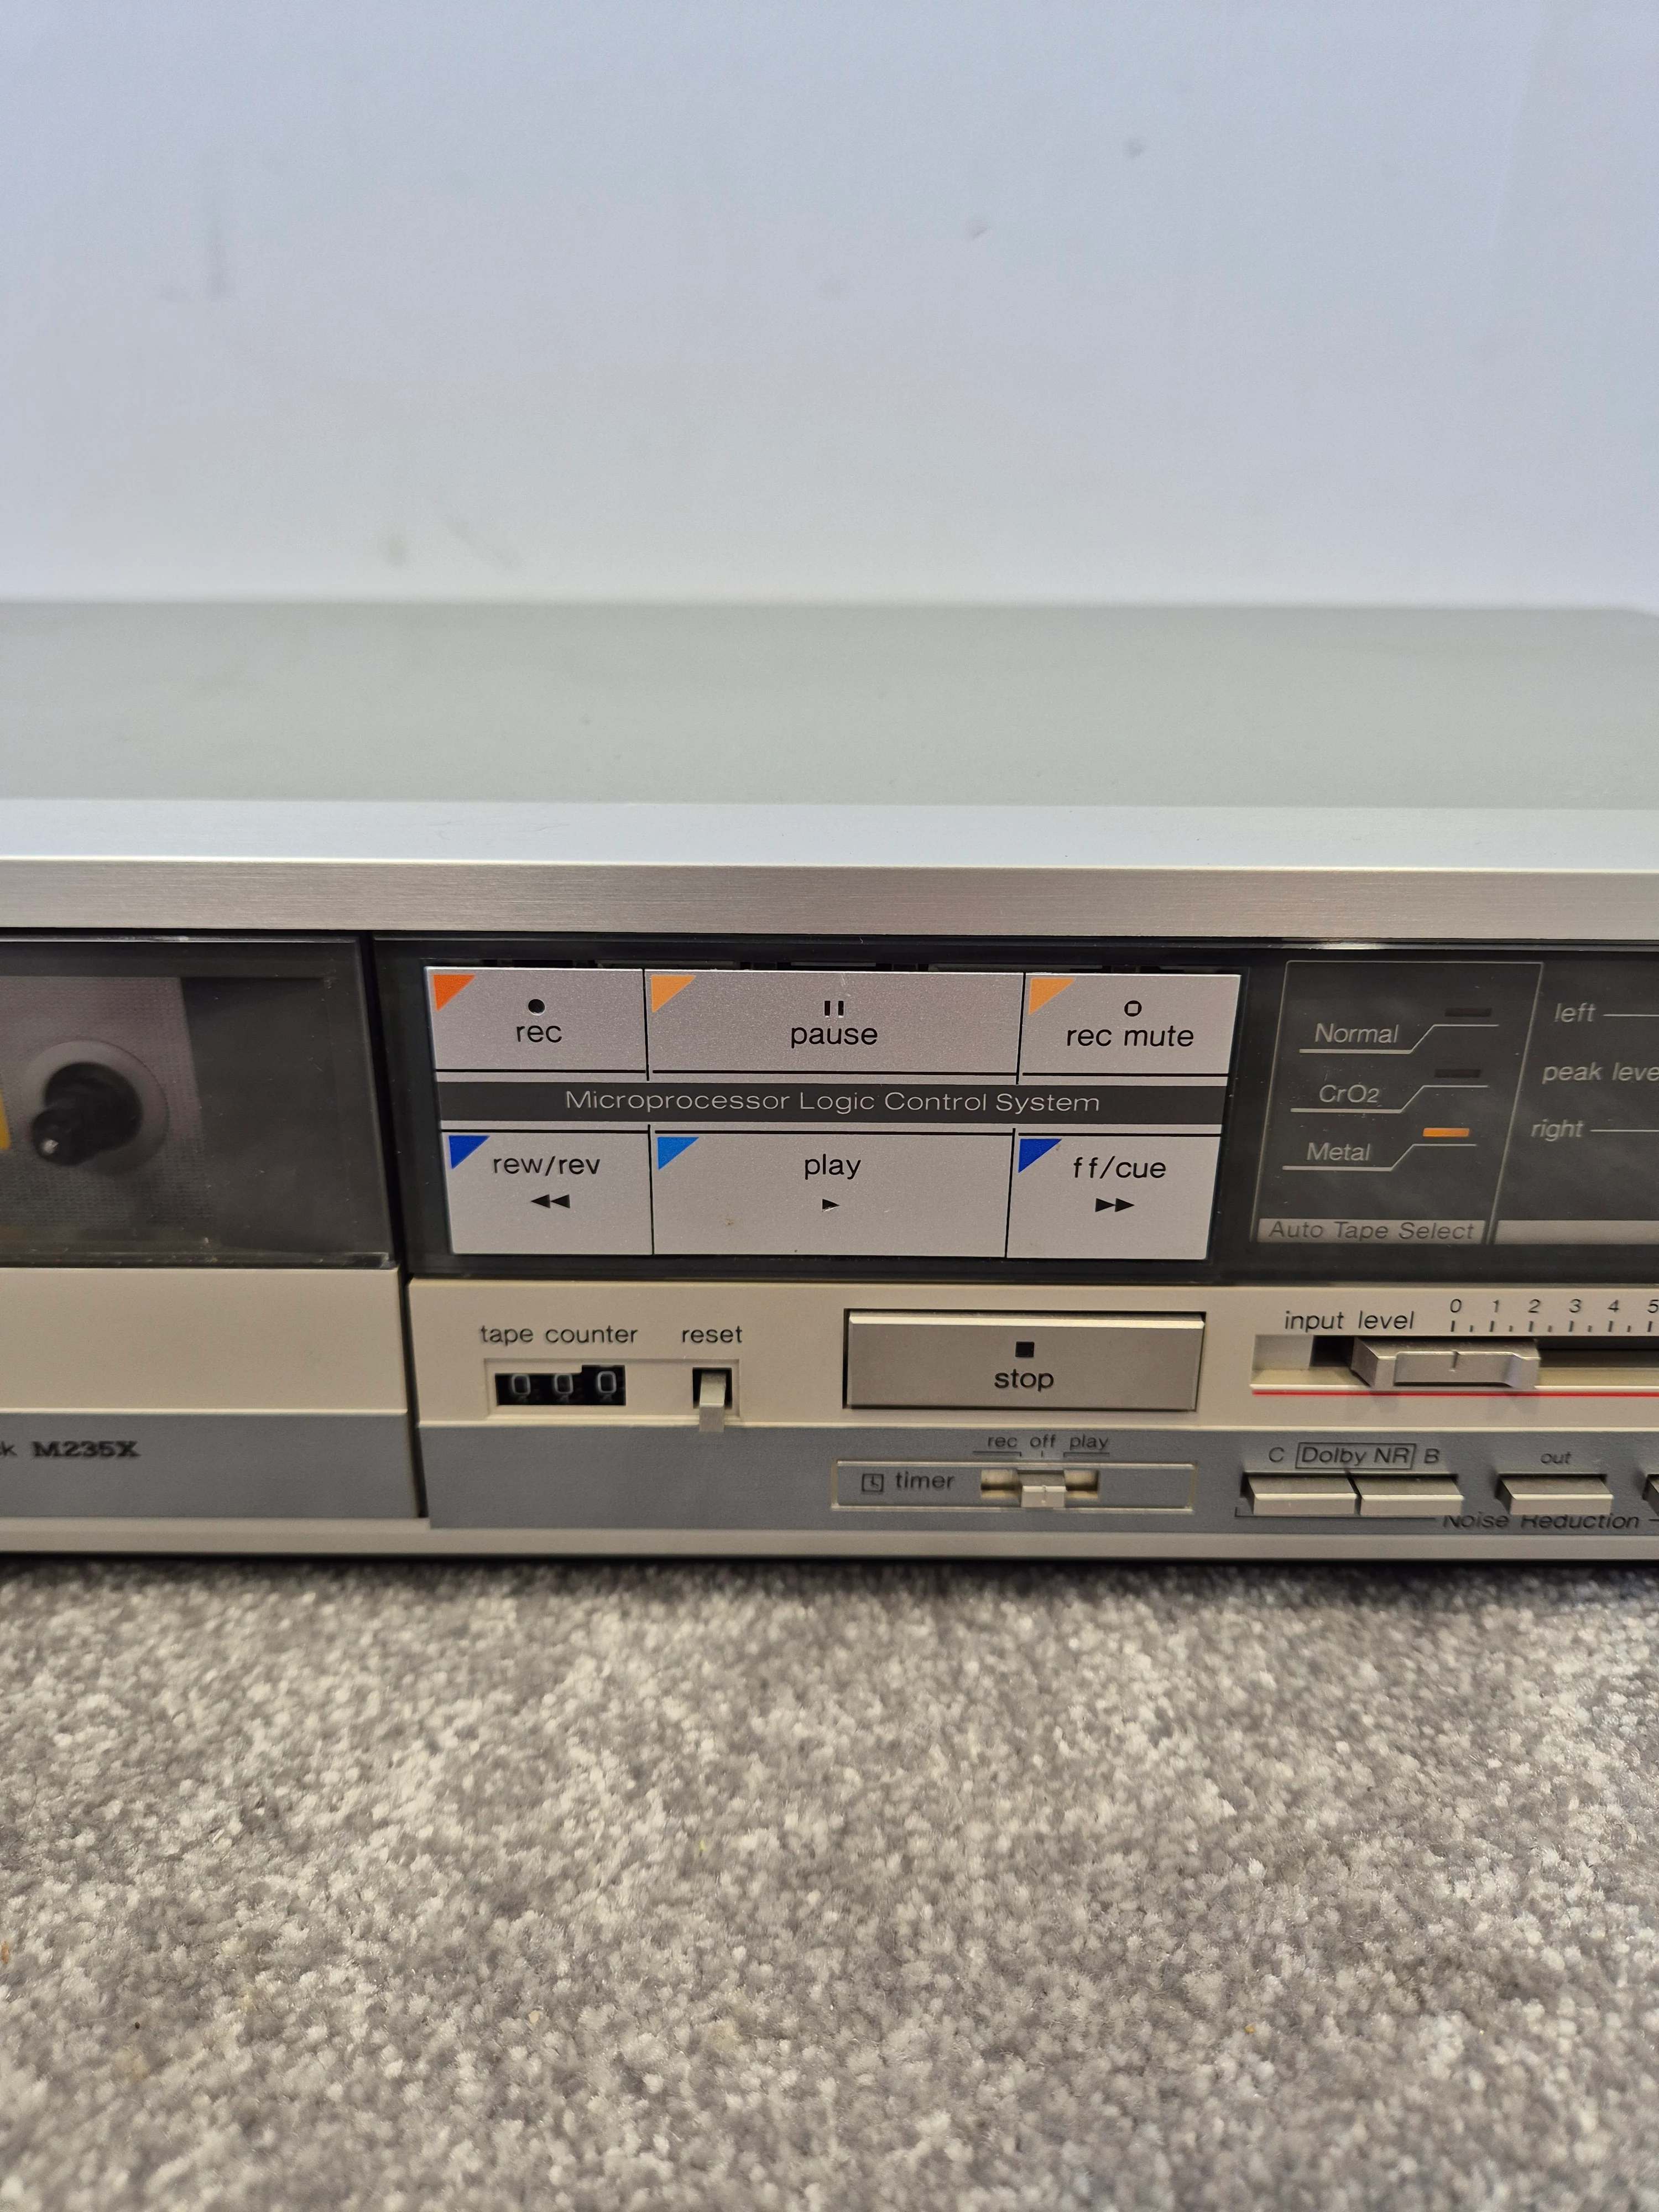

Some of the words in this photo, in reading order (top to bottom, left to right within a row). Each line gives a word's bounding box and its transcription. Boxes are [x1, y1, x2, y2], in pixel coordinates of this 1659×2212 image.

[1554, 1003, 1596, 1023] left
[516, 1023, 562, 1044] rec
[790, 1025, 878, 1049] pause
[1066, 1028, 1112, 1047] rec
[1124, 1025, 1194, 1047] mute
[1314, 1022, 1400, 1044] Normal
[1542, 1061, 1603, 1085] peak
[565, 1090, 791, 1113] Microprocessor
[800, 1091, 875, 1115] Logic
[885, 1091, 987, 1112] Control
[995, 1092, 1100, 1115] System
[1530, 1118, 1584, 1142] right
[1306, 1142, 1371, 1162] Metal
[493, 1155, 601, 1177] rew/rev
[804, 1152, 862, 1180] play
[1073, 1155, 1167, 1179] ff/cue
[1268, 1222, 1324, 1240] Auto
[1333, 1222, 1389, 1243] Tape
[1397, 1223, 1475, 1240] Select
[1449, 1298, 1463, 1314] 0
[1493, 1299, 1500, 1314] 1
[1528, 1299, 1541, 1314] 2
[1569, 1300, 1582, 1314] 3
[1607, 1299, 1619, 1313] 4
[1647, 1299, 1659, 1313] 5
[1284, 1310, 1344, 1334] input
[1358, 1310, 1415, 1331] level
[481, 1324, 534, 1347] tape
[545, 1324, 639, 1344] counter
[681, 1326, 743, 1344] reset
[994, 1369, 1054, 1392] stop
[0, 1440, 18, 1457] k
[32, 1440, 142, 1458] M235X
[987, 1436, 1018, 1449] rec
[1029, 1434, 1056, 1449] off
[1069, 1434, 1110, 1452] play
[1268, 1447, 1285, 1463] C
[1301, 1447, 1368, 1468] Dolby
[1373, 1447, 1410, 1464] NR
[1423, 1448, 1439, 1464] B
[1540, 1451, 1572, 1465] out
[895, 1471, 955, 1490] timer
[1442, 1511, 1510, 1528] Noise
[1520, 1512, 1640, 1529] Reduction
